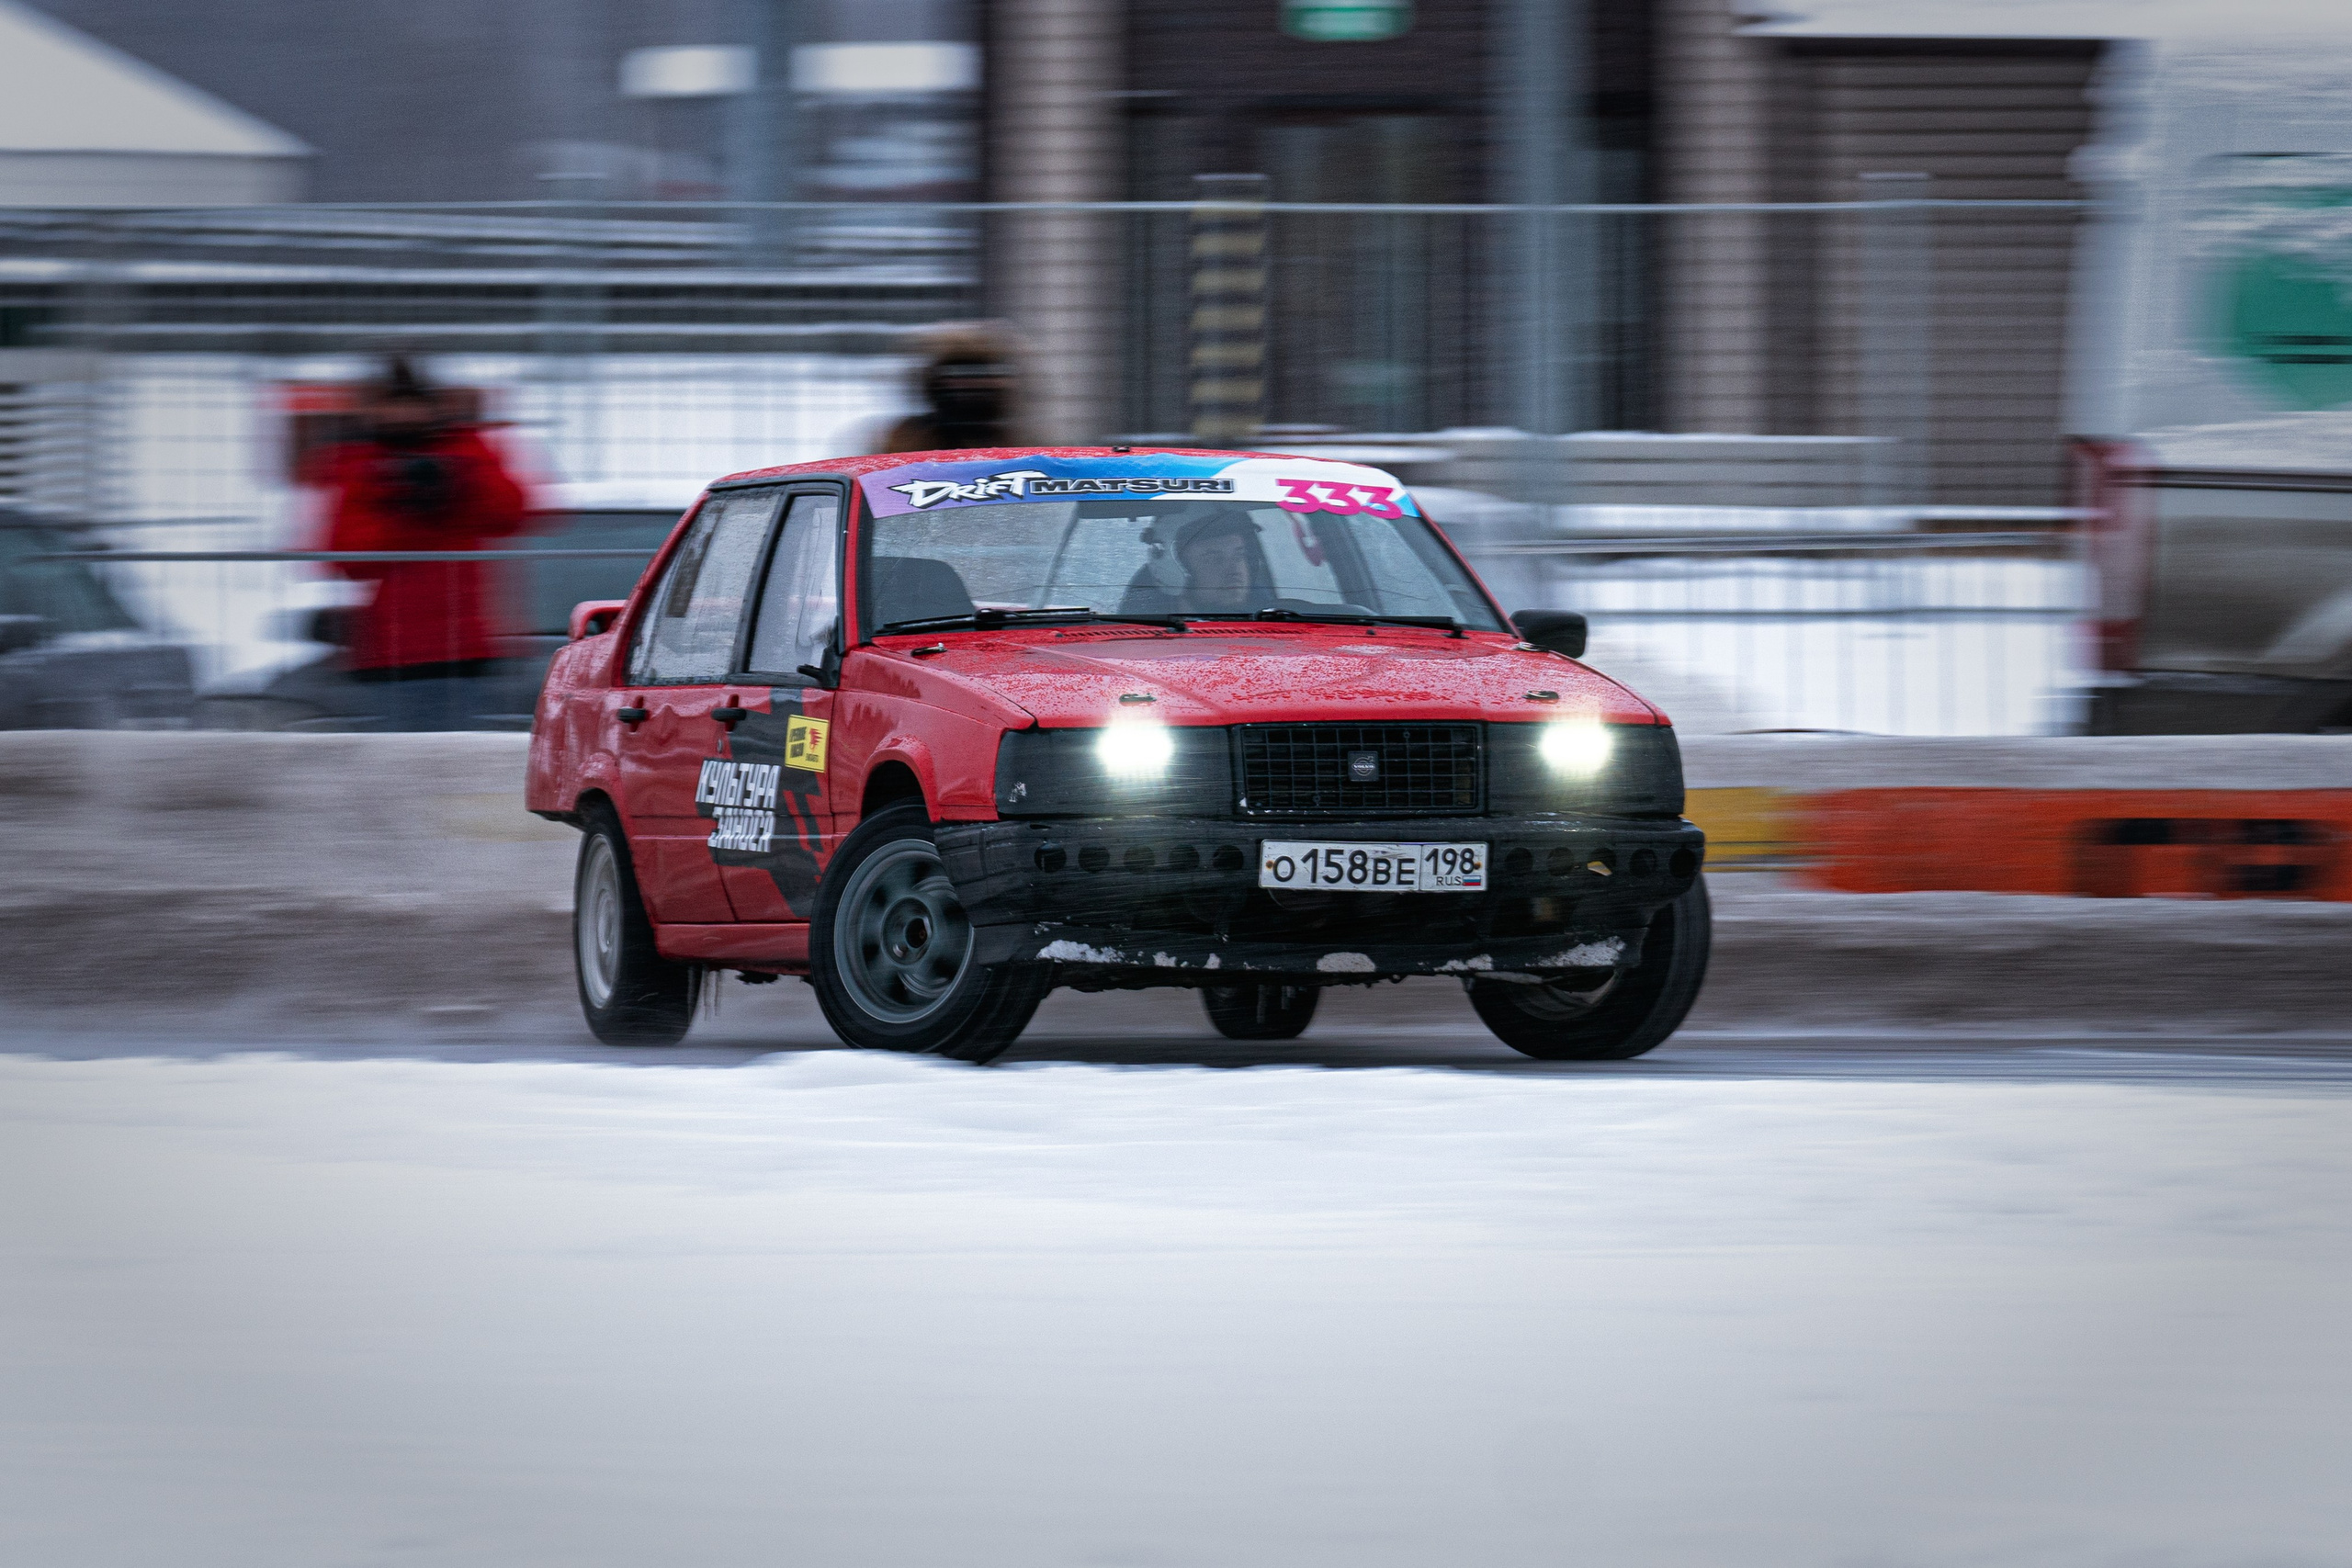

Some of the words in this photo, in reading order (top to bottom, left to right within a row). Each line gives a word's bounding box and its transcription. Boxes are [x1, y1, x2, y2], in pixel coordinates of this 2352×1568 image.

[1030, 478, 1235, 494] MATSURI
[1275, 479, 1403, 520] 333
[695, 760, 781, 809] КУЛЬТУРА
[1424, 848, 1475, 875] 198
[1435, 875, 1462, 886] RUS
